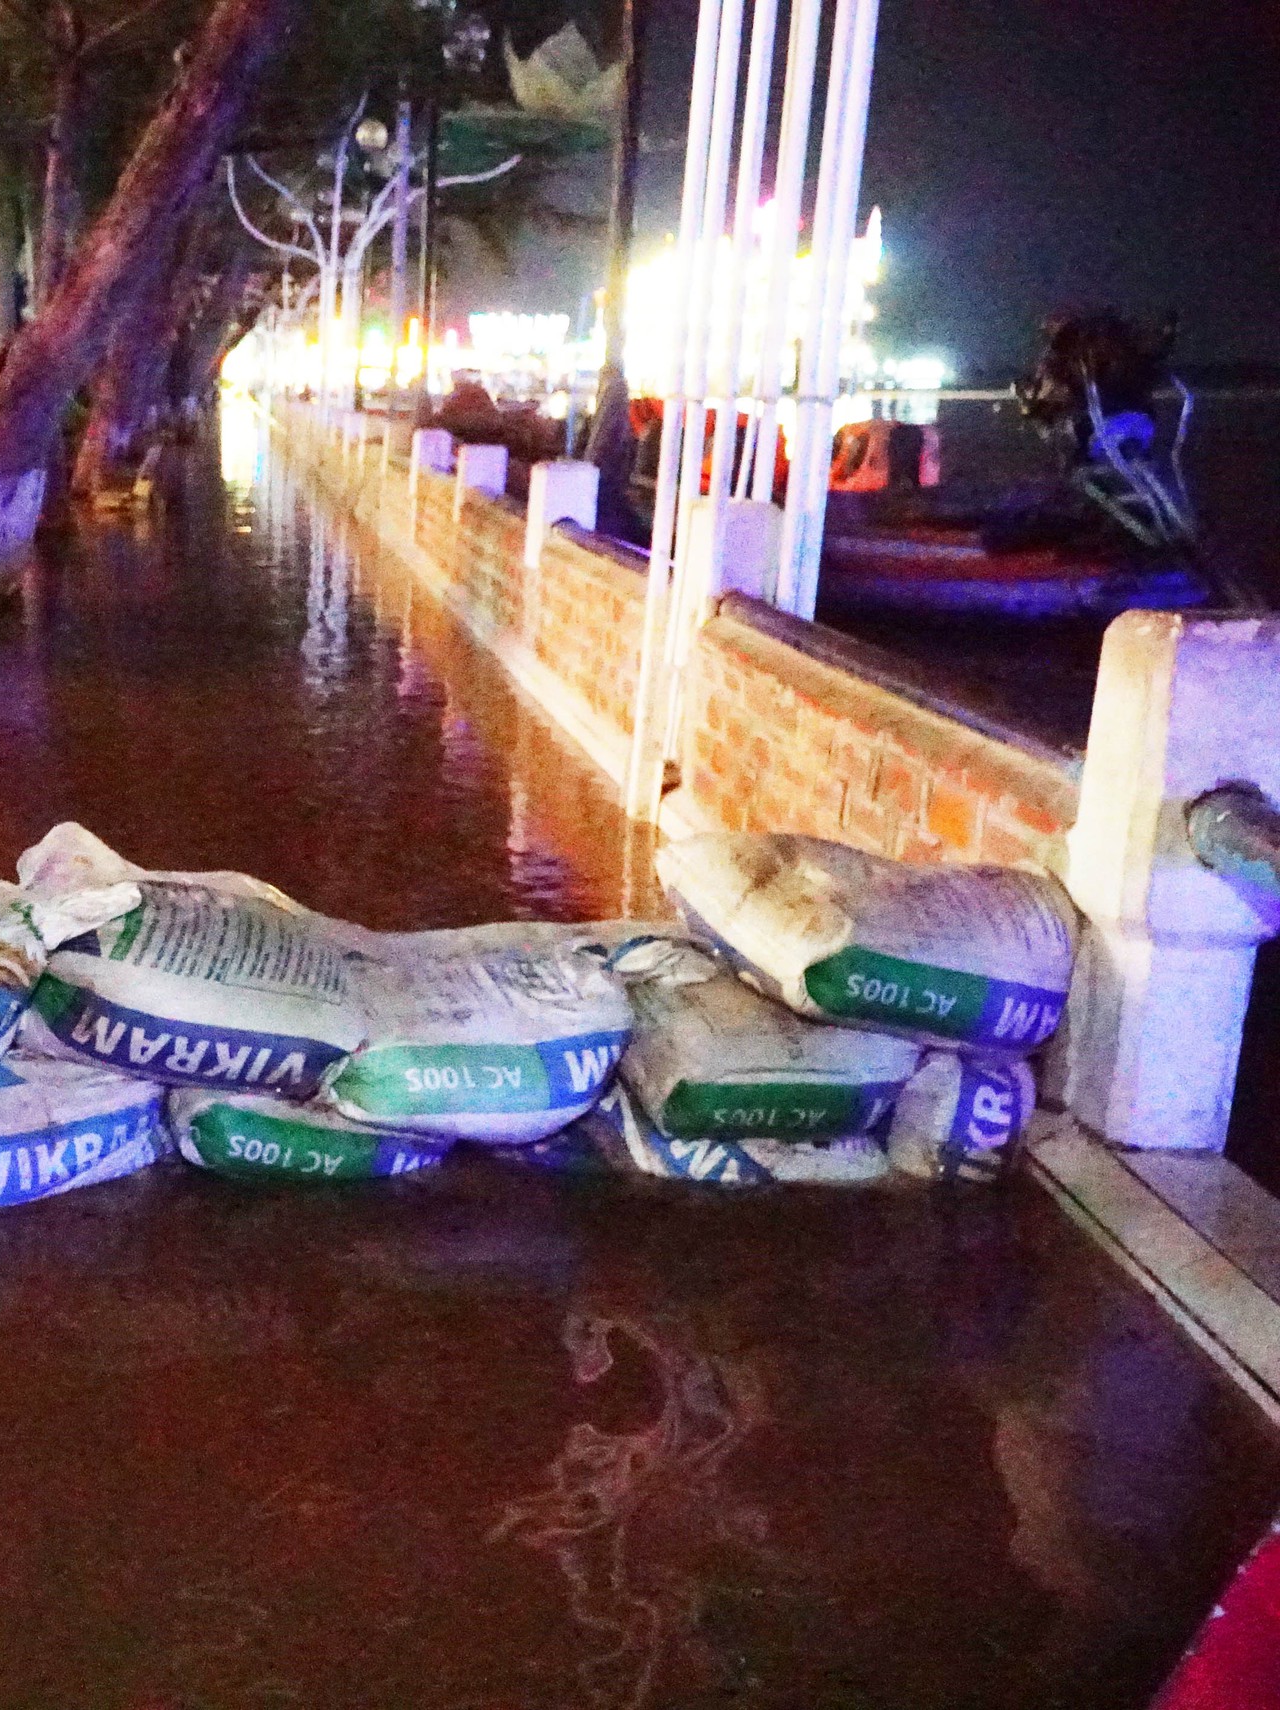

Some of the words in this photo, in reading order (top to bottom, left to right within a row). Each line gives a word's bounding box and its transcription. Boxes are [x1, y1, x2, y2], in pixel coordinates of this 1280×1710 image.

[847, 972, 910, 1007] 100S
[916, 989, 957, 1018] AC
[403, 1065, 476, 1092] 100S
[483, 1067, 521, 1088] AC
[228, 1134, 293, 1168] 100S
[301, 1151, 345, 1175] AC
